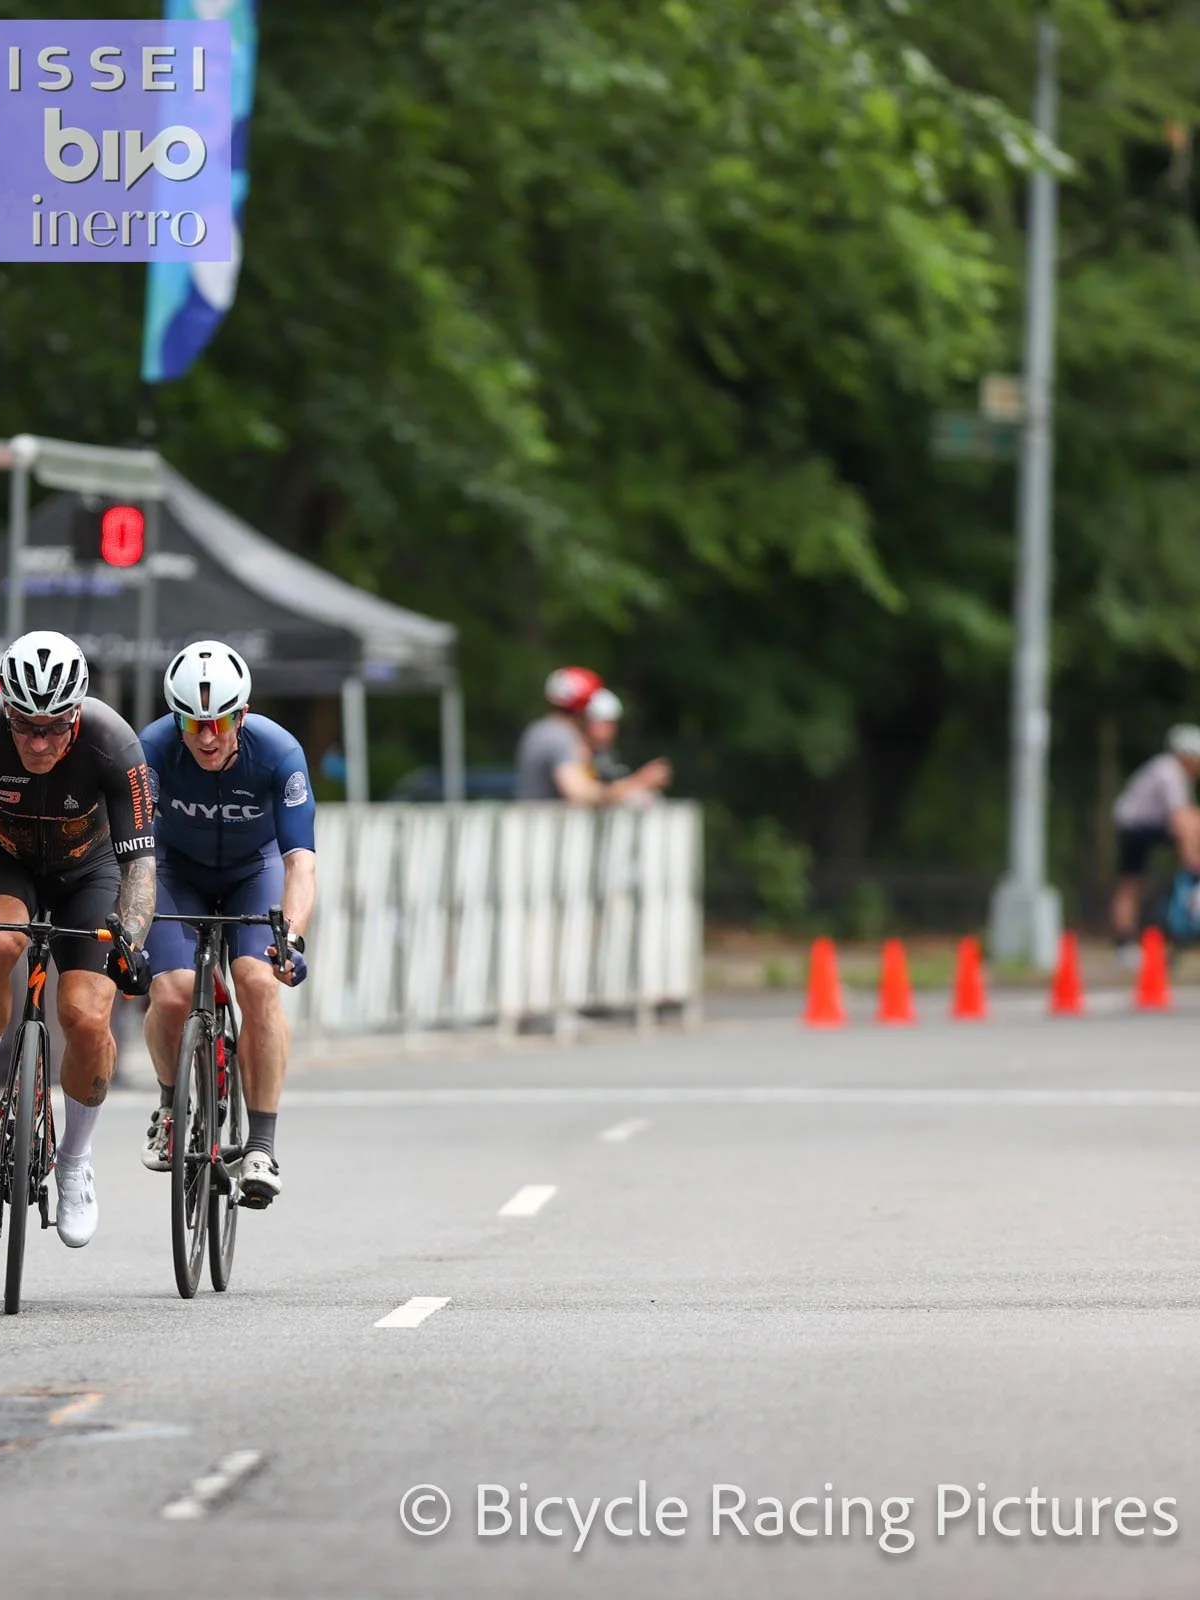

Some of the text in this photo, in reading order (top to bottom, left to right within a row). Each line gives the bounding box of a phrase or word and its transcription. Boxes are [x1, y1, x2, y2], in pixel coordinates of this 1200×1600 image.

[127, 767, 144, 829] Bathhouse
[171, 799, 264, 819] NYCC
[115, 836, 155, 854] UNITED
